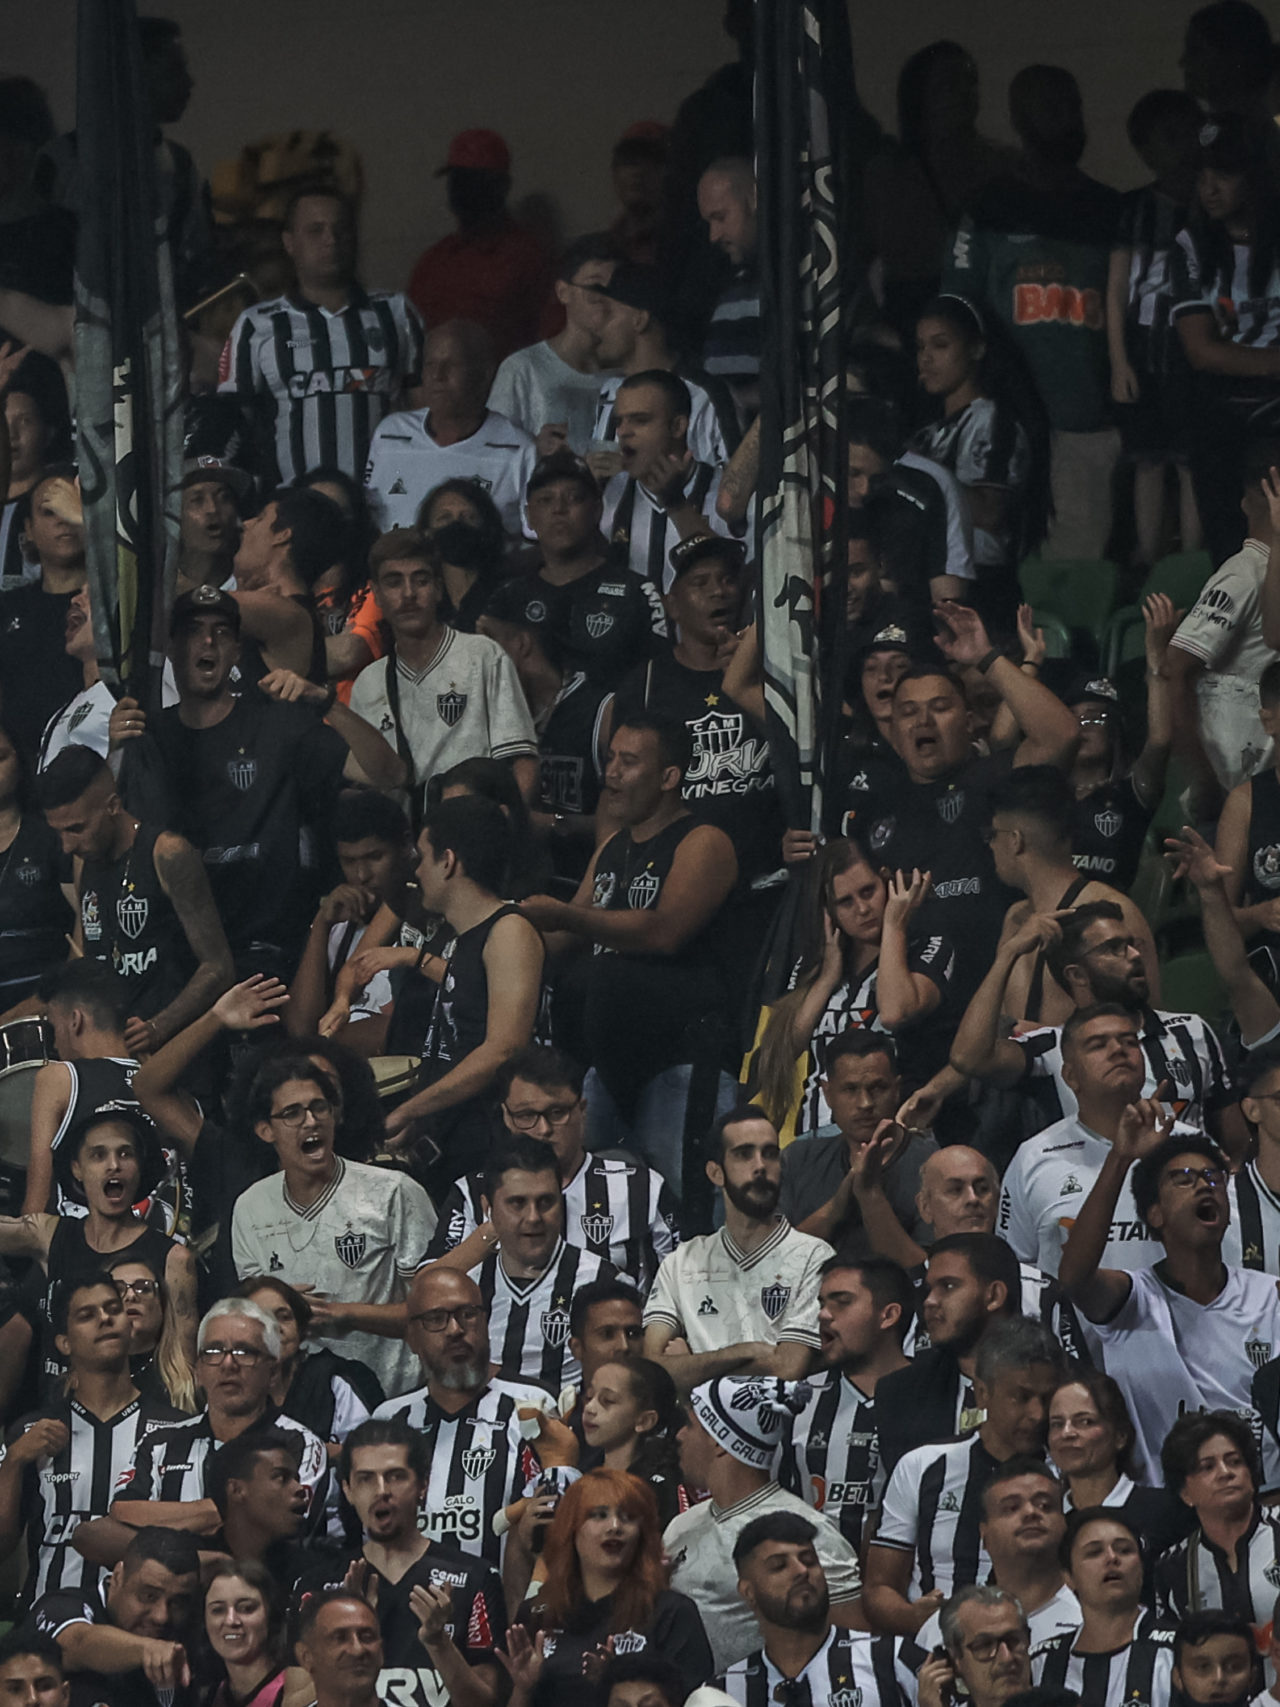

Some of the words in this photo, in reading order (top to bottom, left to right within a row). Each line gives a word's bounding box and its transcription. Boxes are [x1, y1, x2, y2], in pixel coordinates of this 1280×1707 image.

[640, 581, 668, 639] MRV
[690, 719, 738, 737] CAM
[1071, 854, 1116, 873] TANO
[119, 902, 144, 911] CAM
[920, 935, 943, 964] MRV
[999, 1186, 1012, 1231] MRV
[446, 1207, 464, 1244] MRV
[585, 1216, 610, 1225] CAM
[340, 1236, 363, 1247] CAM
[546, 1315, 571, 1323] CAM
[120, 1400, 141, 1418] UBER
[700, 1404, 729, 1442] GALO
[467, 1451, 492, 1459] CAM
[44, 1471, 81, 1484] Topper
[445, 1495, 475, 1508] GALO
[416, 1503, 482, 1541] bmg
[429, 1567, 469, 1587] cemil
